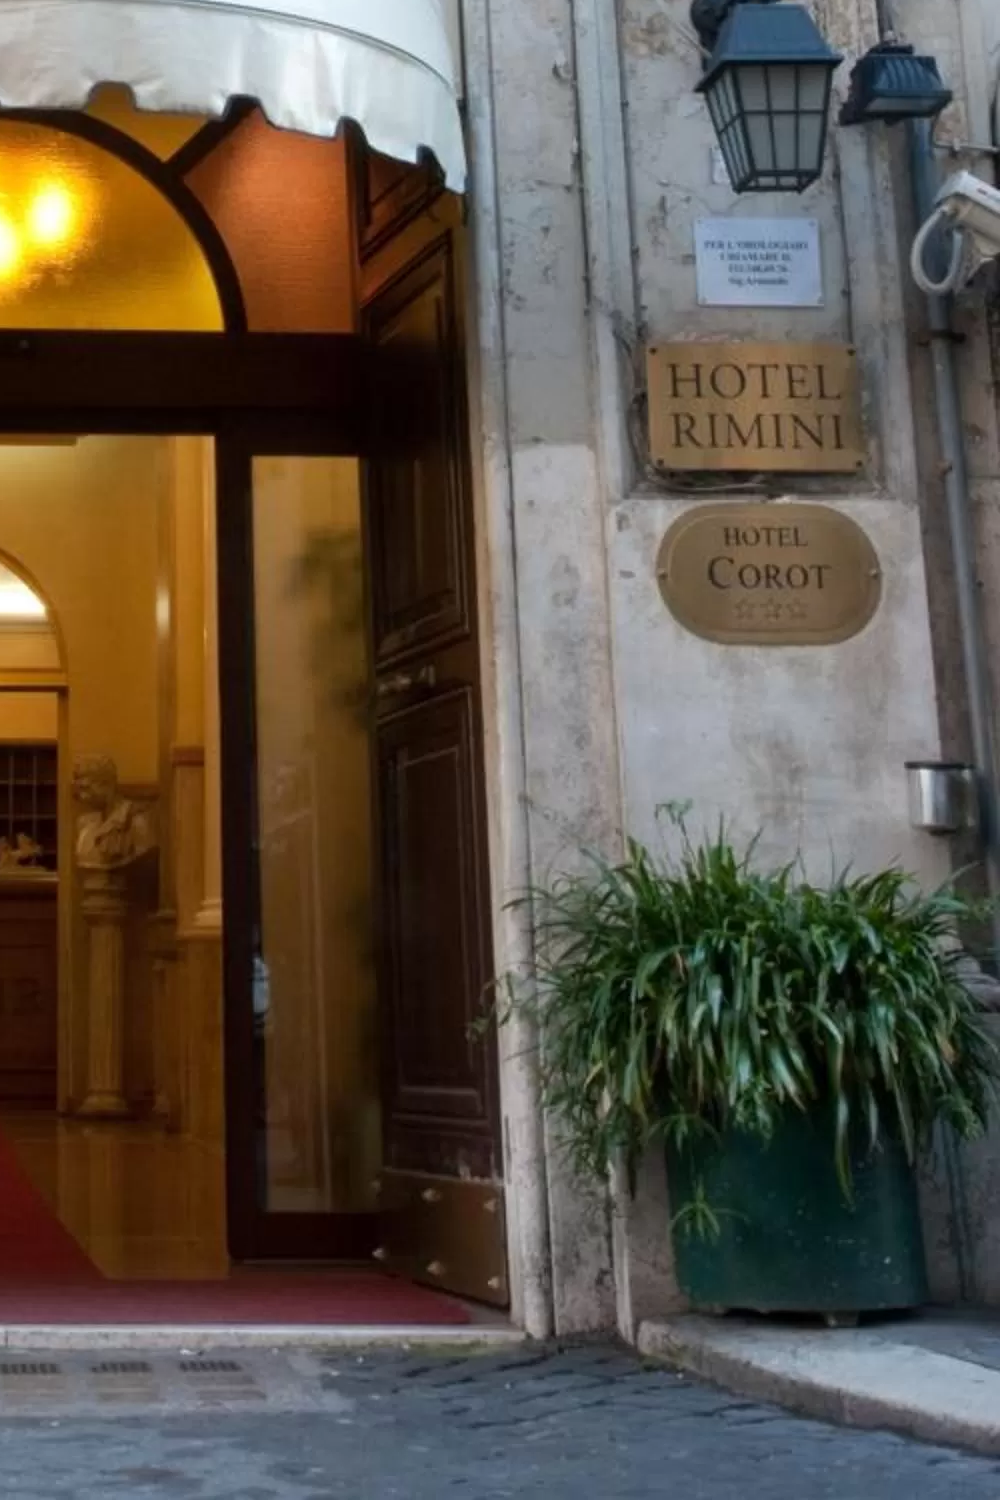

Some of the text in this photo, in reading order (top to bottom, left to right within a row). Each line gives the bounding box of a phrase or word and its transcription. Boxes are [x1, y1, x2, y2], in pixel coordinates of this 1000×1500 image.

[667, 363, 842, 400] HOTEL
[670, 412, 845, 450] RIMINI
[722, 525, 809, 548] HOTEL
[707, 555, 833, 590] COROT
